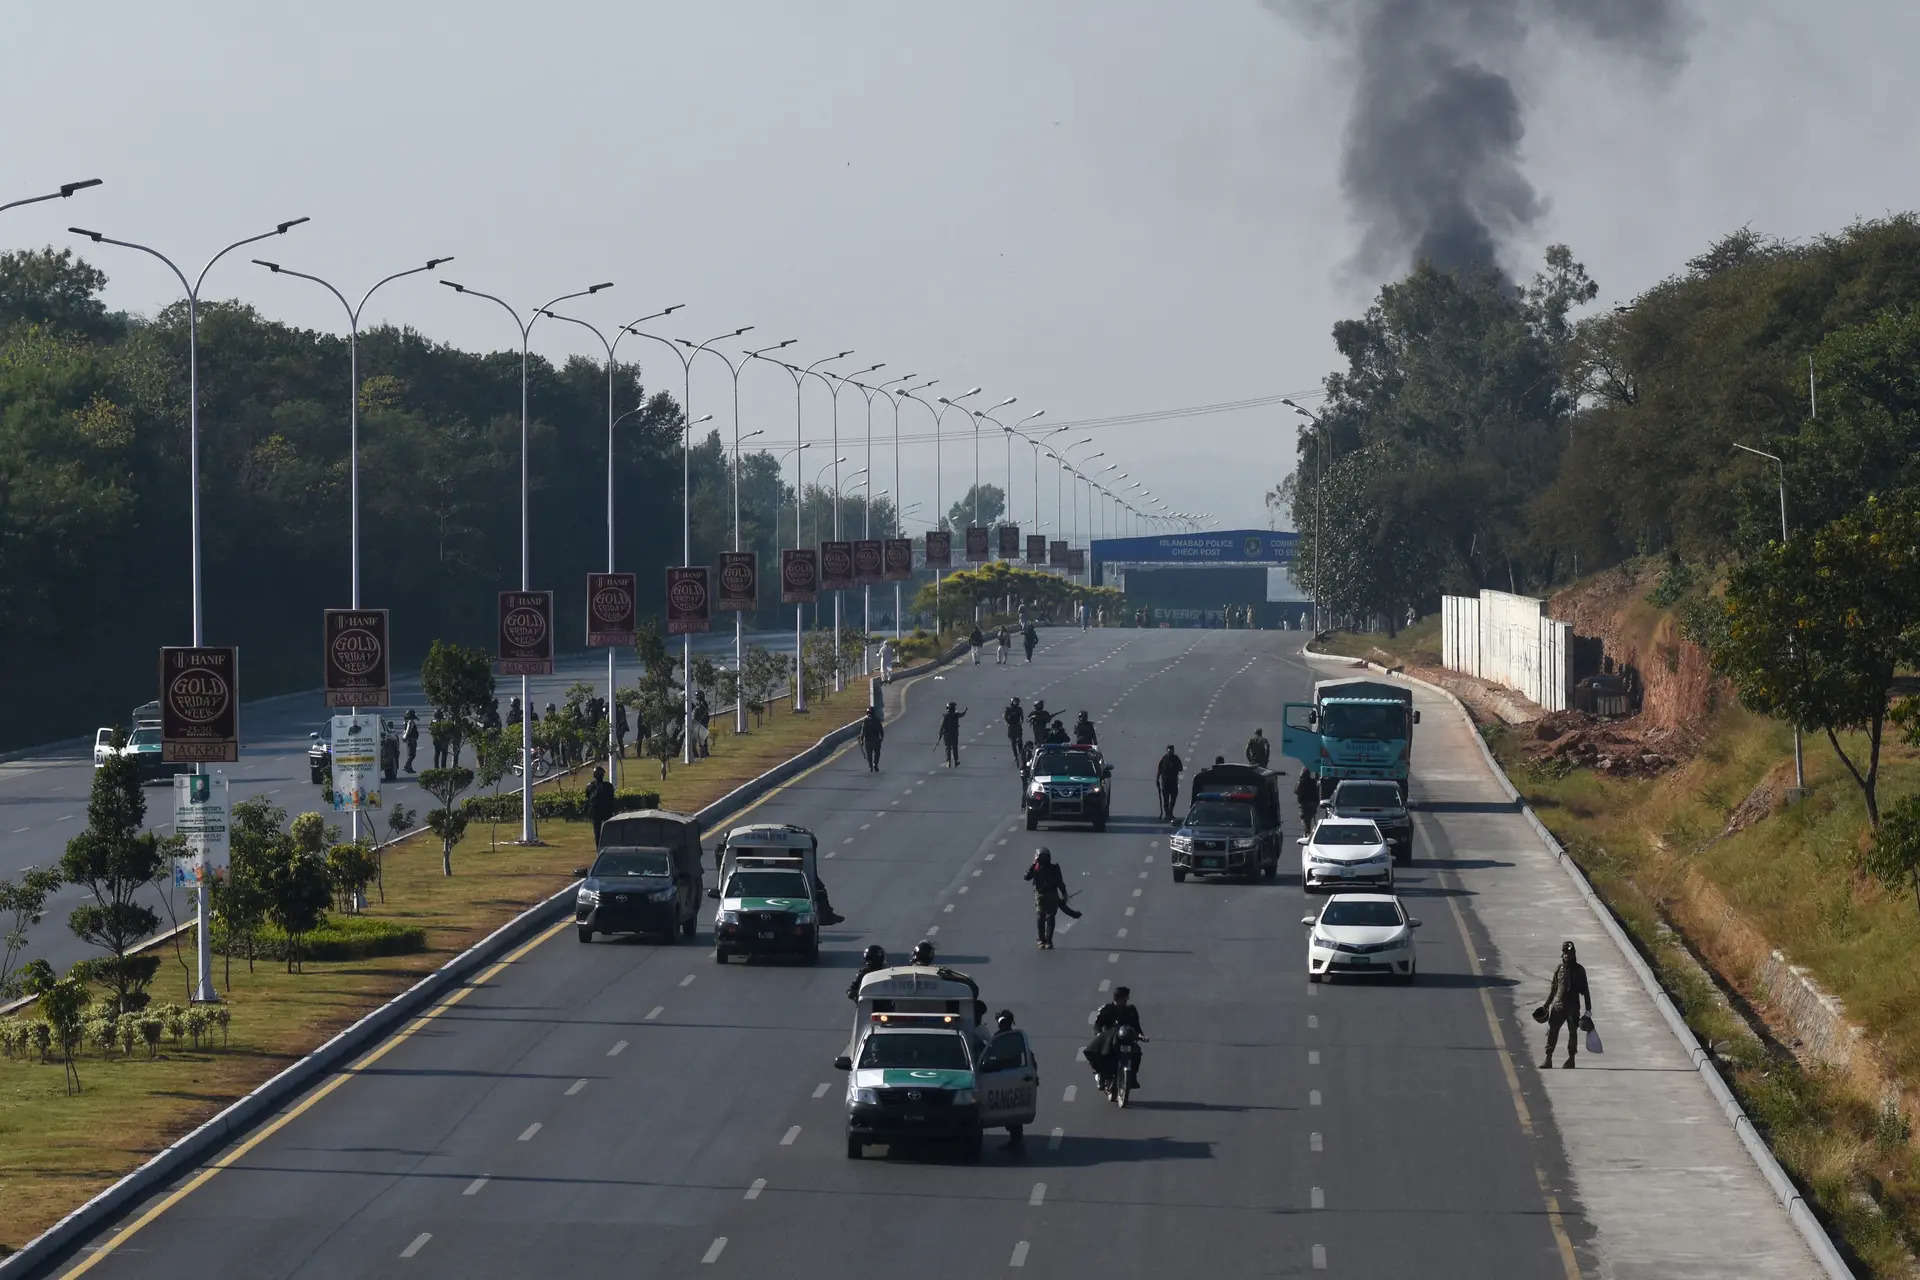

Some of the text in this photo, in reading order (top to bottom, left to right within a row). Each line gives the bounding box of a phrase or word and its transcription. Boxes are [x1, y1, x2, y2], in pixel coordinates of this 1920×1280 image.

[1159, 539, 1233, 547] ISLAMABAD POLICE
[1171, 548, 1221, 556] CHECK POST
[336, 636, 377, 651] GOLD
[191, 655, 226, 665] HANIF
[174, 678, 224, 695] GOLD
[175, 695, 222, 708] FRIDAY
